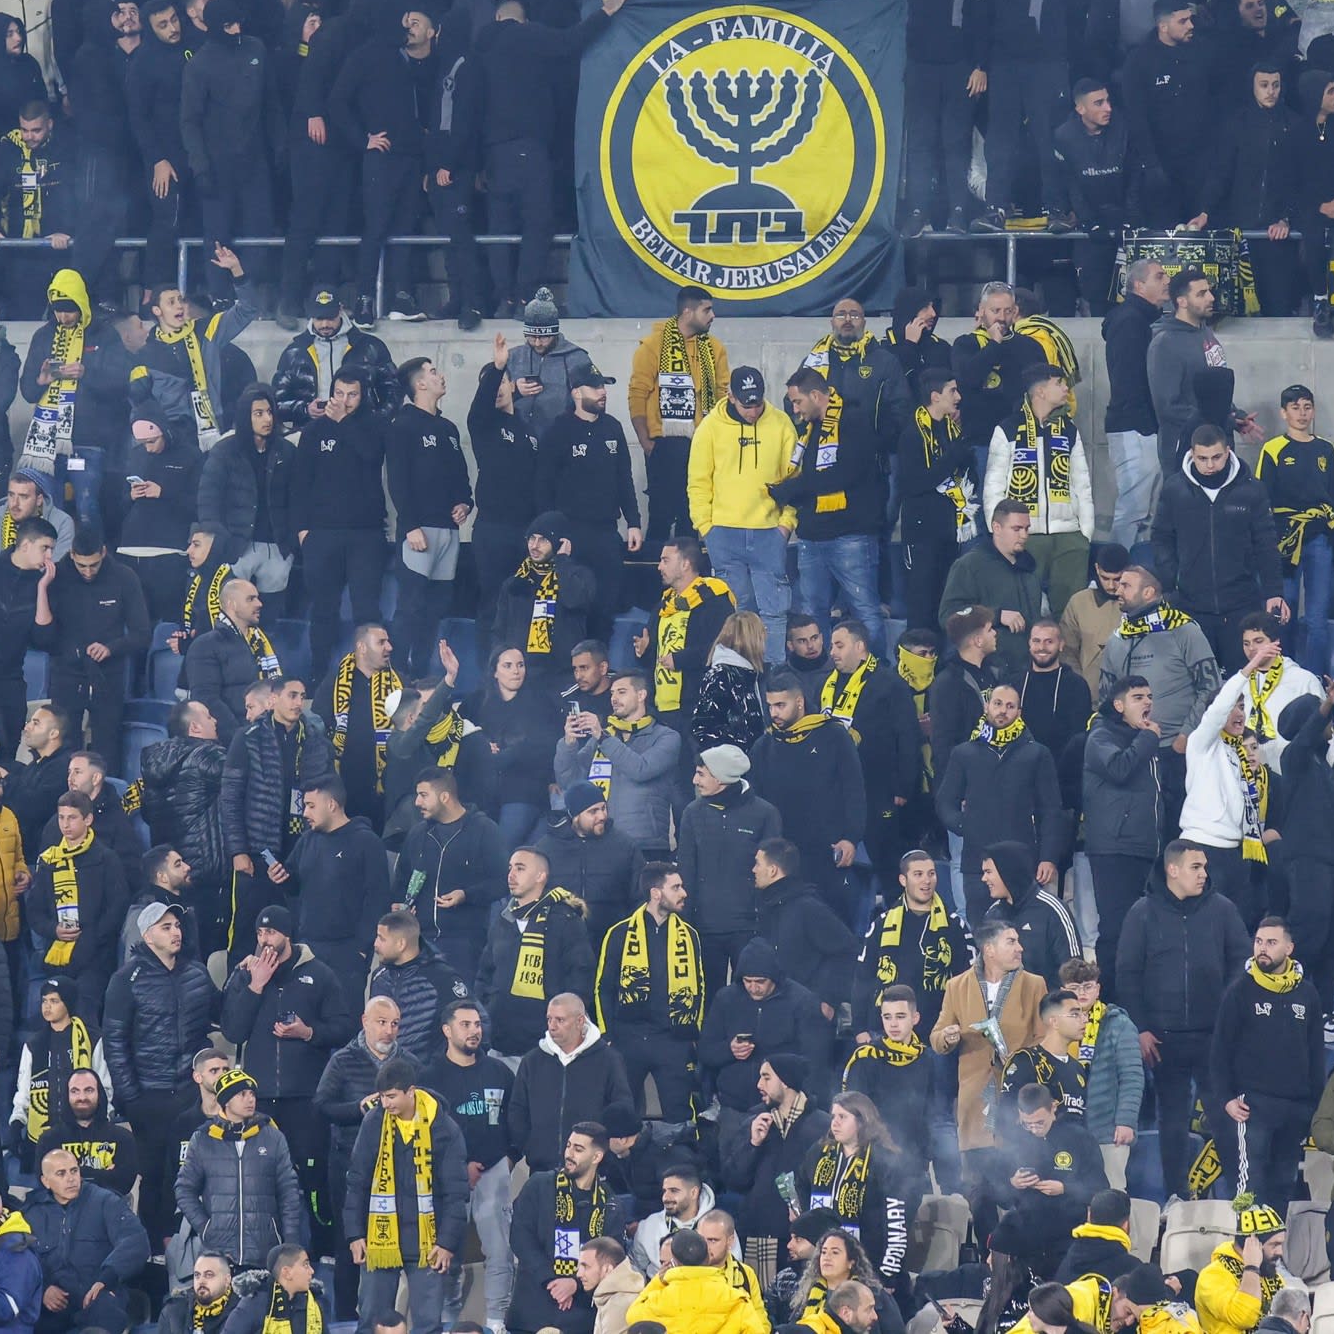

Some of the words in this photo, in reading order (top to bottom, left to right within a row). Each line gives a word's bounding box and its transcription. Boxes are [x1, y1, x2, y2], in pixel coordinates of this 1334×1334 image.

[645, 39, 692, 78] LA
[706, 15, 839, 77] FAMILIA
[628, 215, 712, 285] BEITAR
[714, 211, 857, 289] JERUSALEM
[670, 209, 807, 245] ביתר
[518, 970, 544, 986] 1936
